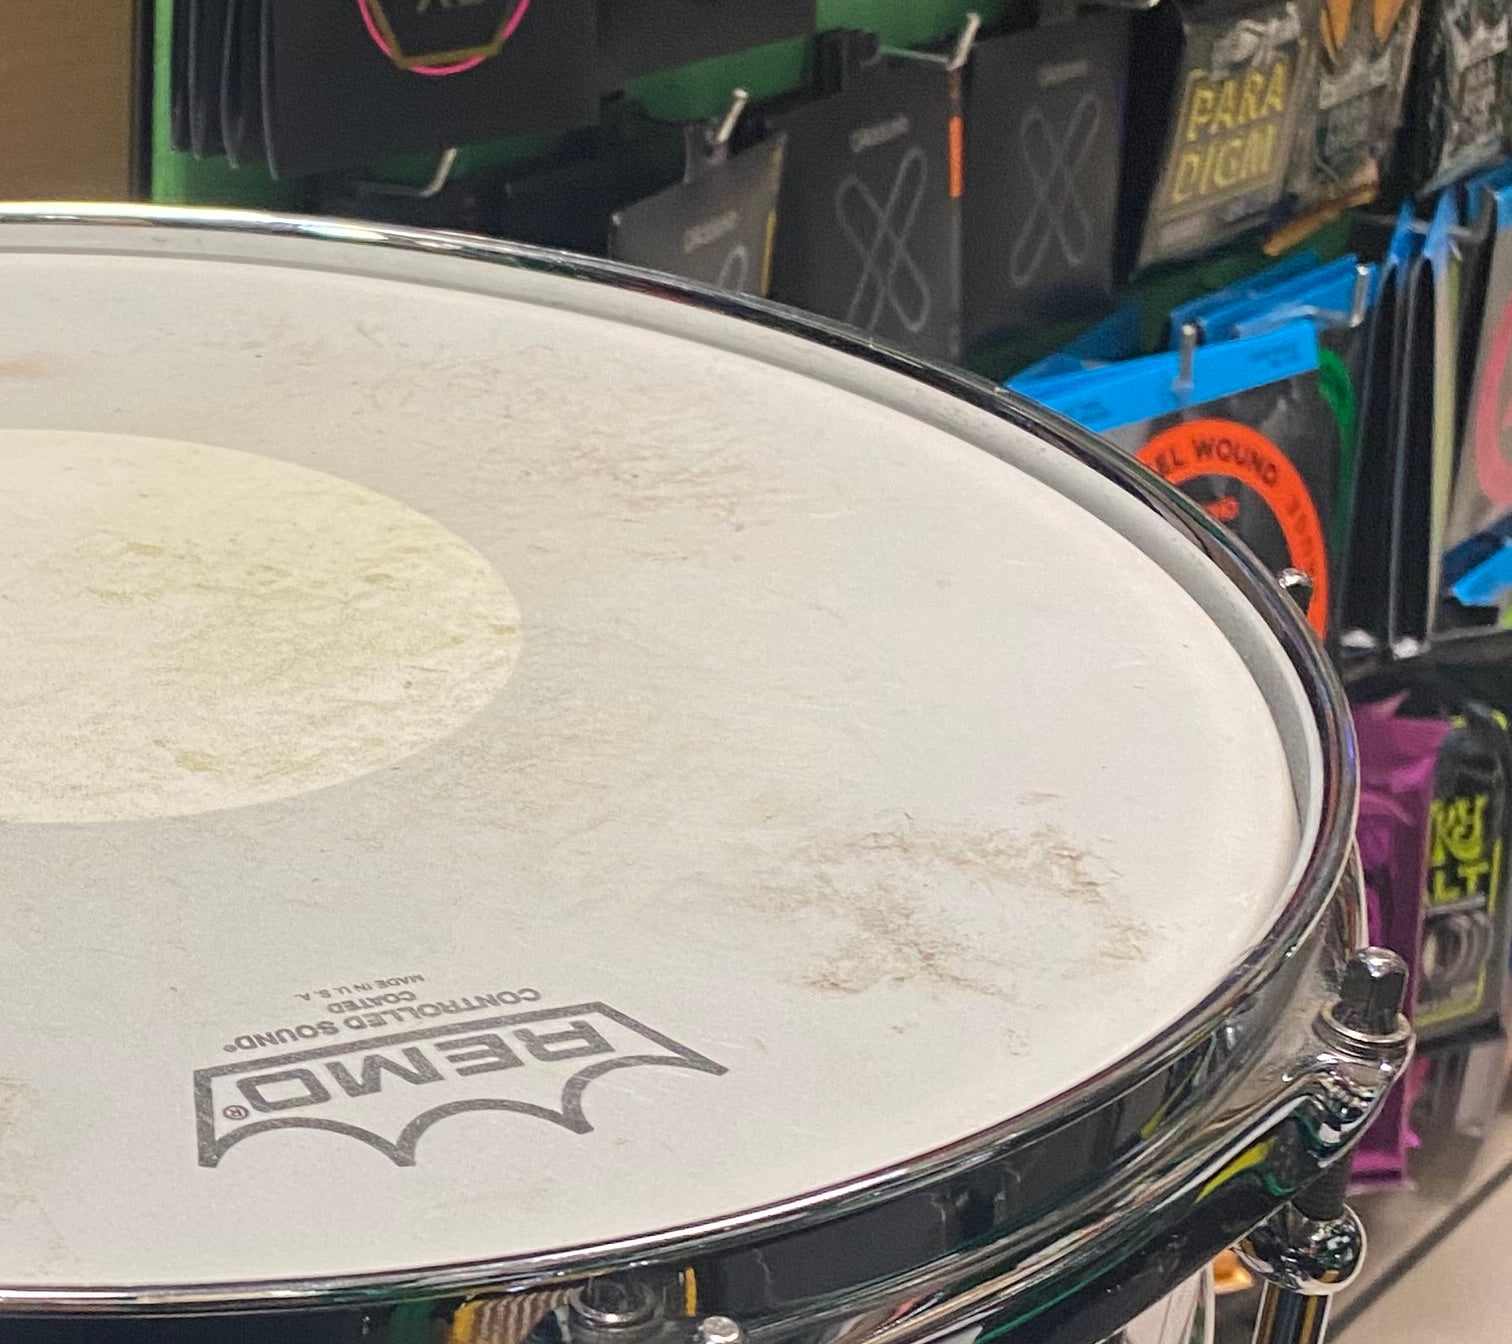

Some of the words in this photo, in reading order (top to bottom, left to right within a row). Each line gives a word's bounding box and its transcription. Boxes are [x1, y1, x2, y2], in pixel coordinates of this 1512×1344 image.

[1187, 62, 1285, 142] PARA
[1172, 124, 1277, 204] DIGM
[1192, 438, 1278, 487] WOUND
[327, 990, 417, 1015] COATED
[354, 982, 373, 992] IN
[375, 973, 425, 990] MADE
[342, 987, 542, 1031] CONTROLLED
